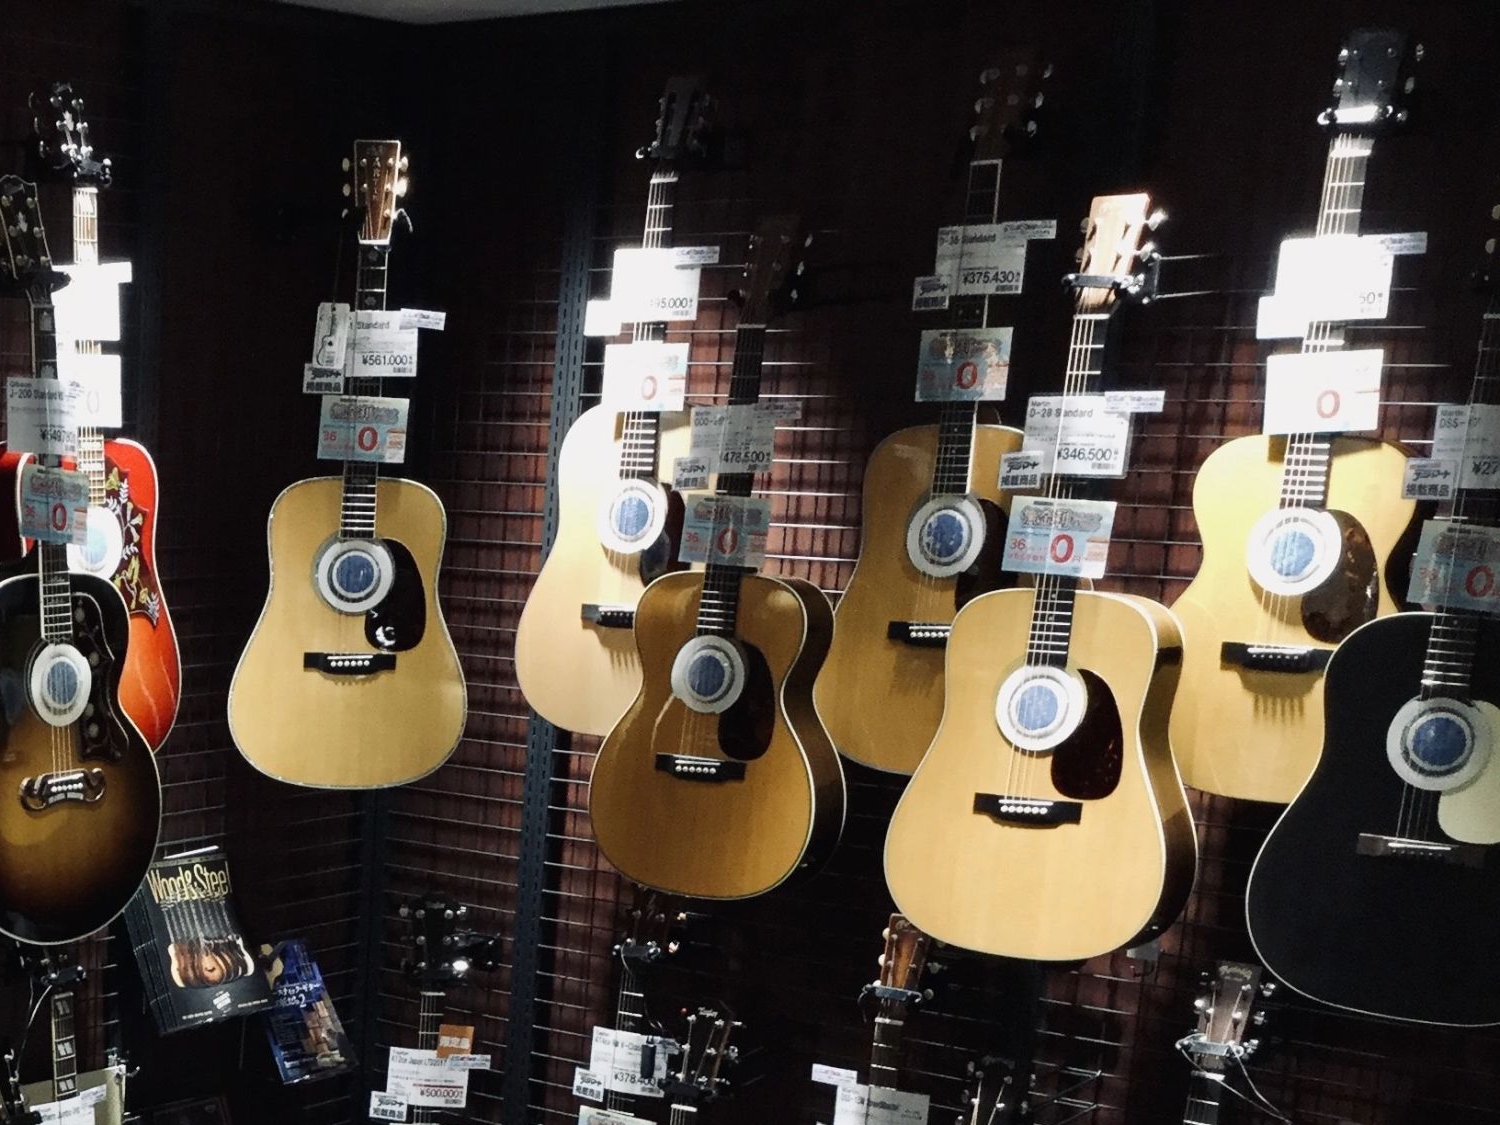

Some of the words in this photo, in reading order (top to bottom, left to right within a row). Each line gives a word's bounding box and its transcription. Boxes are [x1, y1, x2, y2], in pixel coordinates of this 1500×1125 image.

[955, 361, 979, 390] 0
[1316, 389, 1341, 419] 0
[357, 425, 379, 452] 0
[51, 502, 68, 532] 0
[1050, 533, 1075, 564] 0
[1465, 565, 1495, 598] 0
